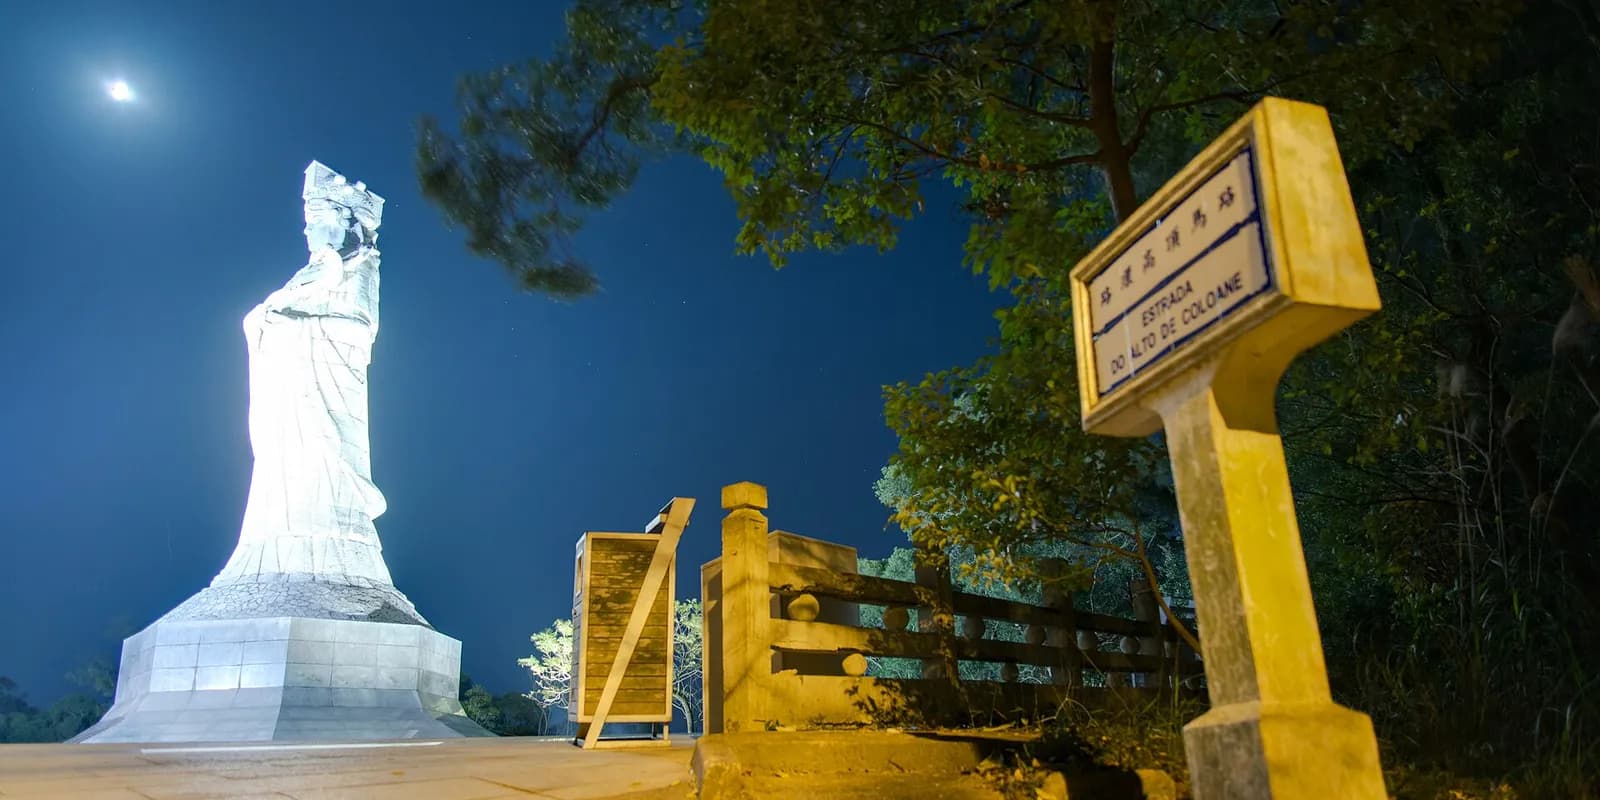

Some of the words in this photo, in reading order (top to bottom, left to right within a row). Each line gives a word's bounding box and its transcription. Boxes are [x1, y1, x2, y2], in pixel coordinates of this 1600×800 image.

[1111, 354, 1125, 375] DO
[1131, 332, 1156, 359] ALTO
[1160, 317, 1177, 340] DE
[1181, 271, 1243, 325] COLOANE
[1142, 280, 1193, 327] ESTRADA
